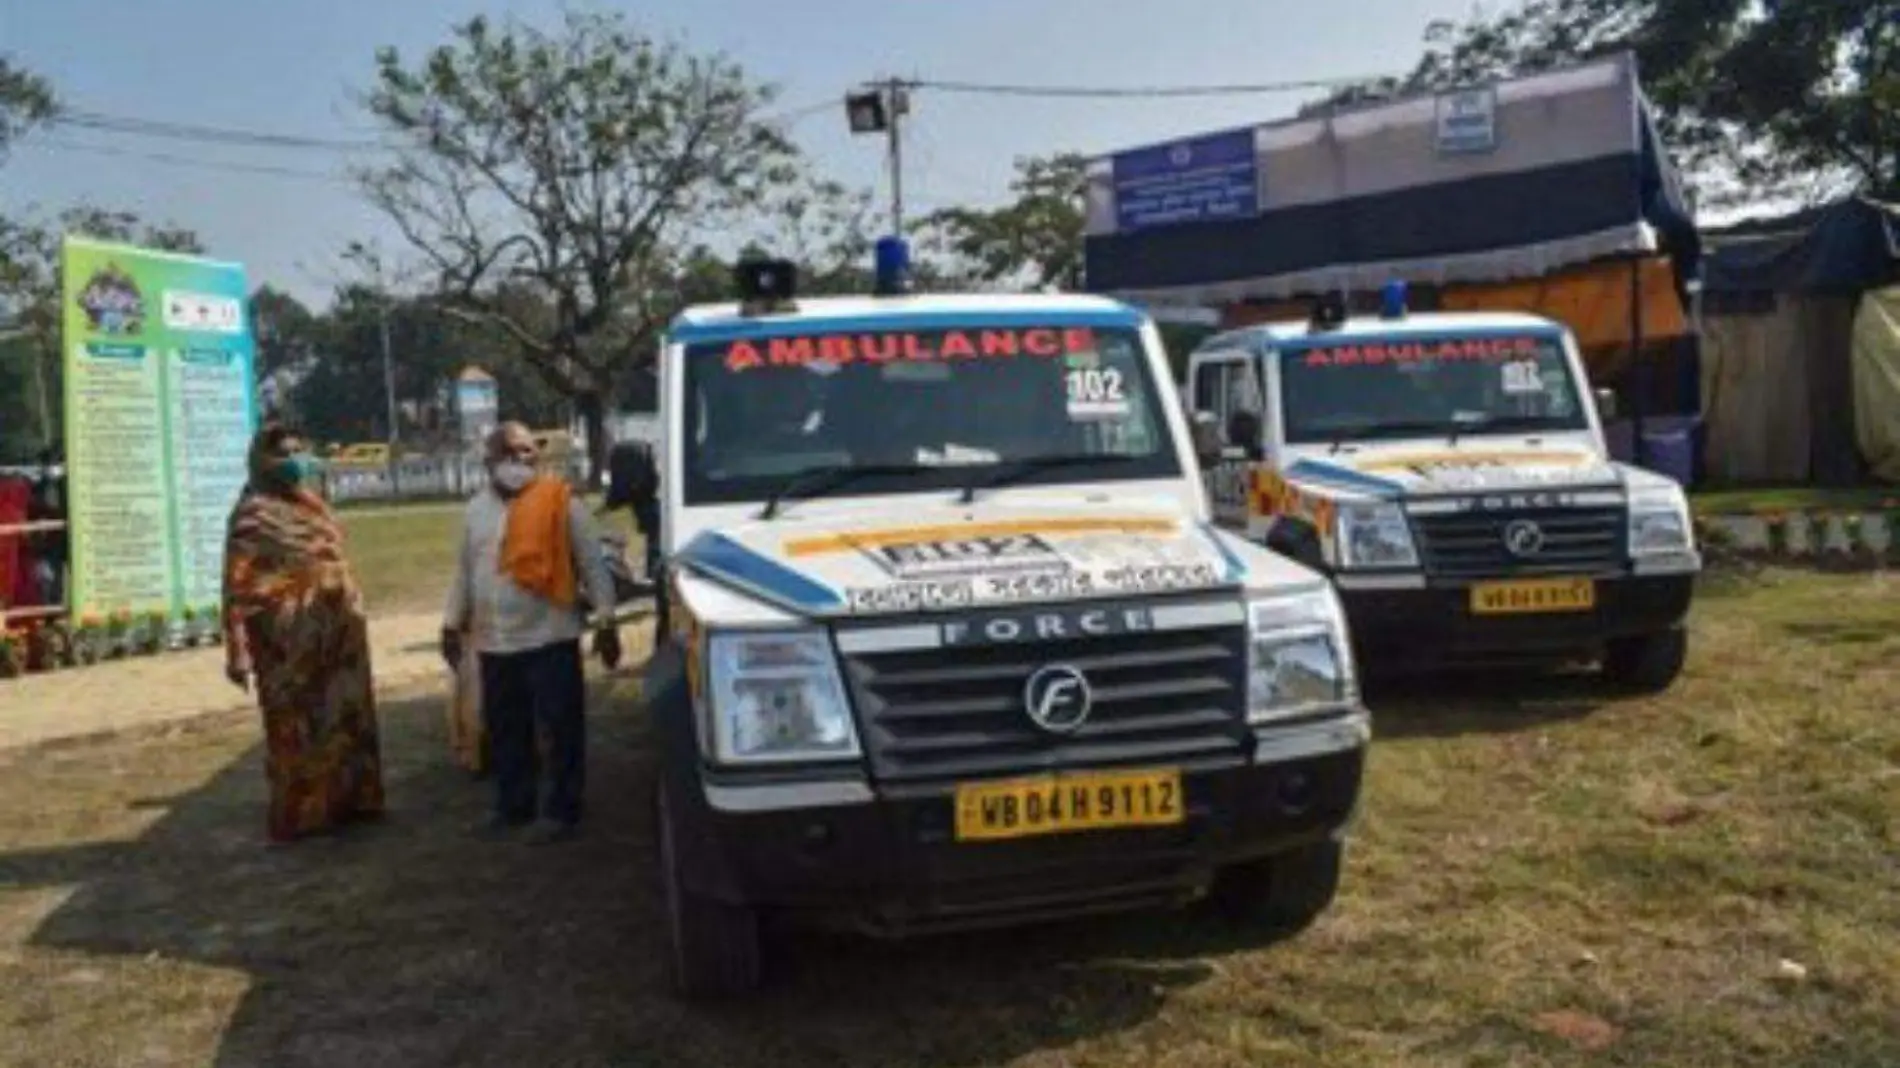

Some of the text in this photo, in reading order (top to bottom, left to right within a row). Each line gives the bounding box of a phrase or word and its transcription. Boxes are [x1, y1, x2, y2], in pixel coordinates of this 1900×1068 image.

[724, 328, 1096, 370] AMBULANCE
[1306, 338, 1538, 367] AMBULANCE
[1066, 368, 1123, 401] 102
[943, 607, 1151, 643] FORCE
